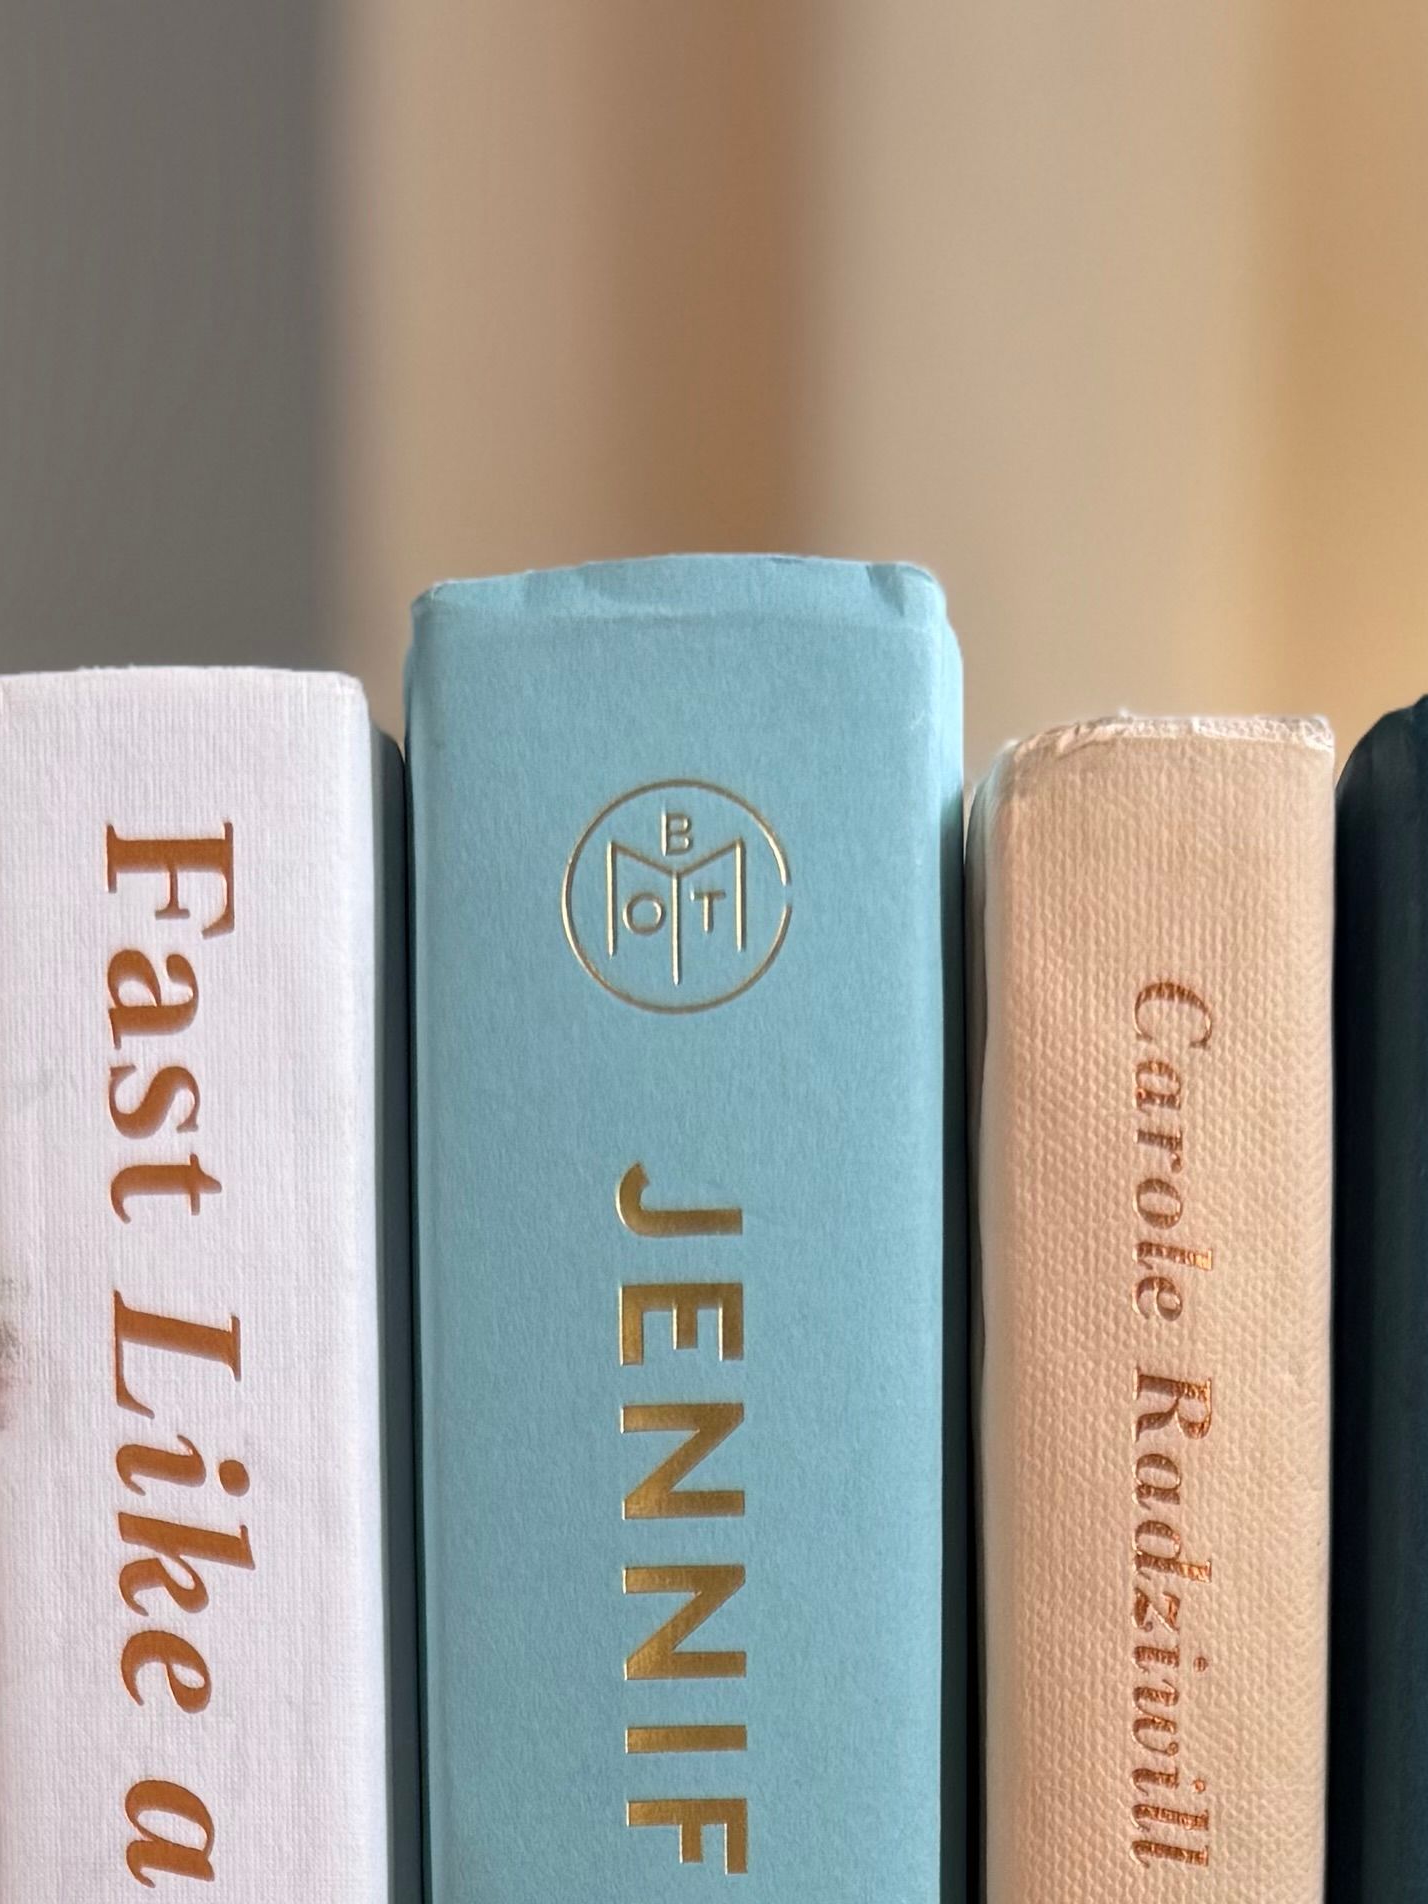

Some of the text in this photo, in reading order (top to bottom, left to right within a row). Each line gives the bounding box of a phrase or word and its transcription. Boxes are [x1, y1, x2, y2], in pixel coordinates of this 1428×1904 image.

[105, 820, 236, 1224] Fast
[112, 1288, 256, 1712] Like
[1131, 974, 1215, 1869] Carole Radziwill
[123, 1785, 216, 1889] a
